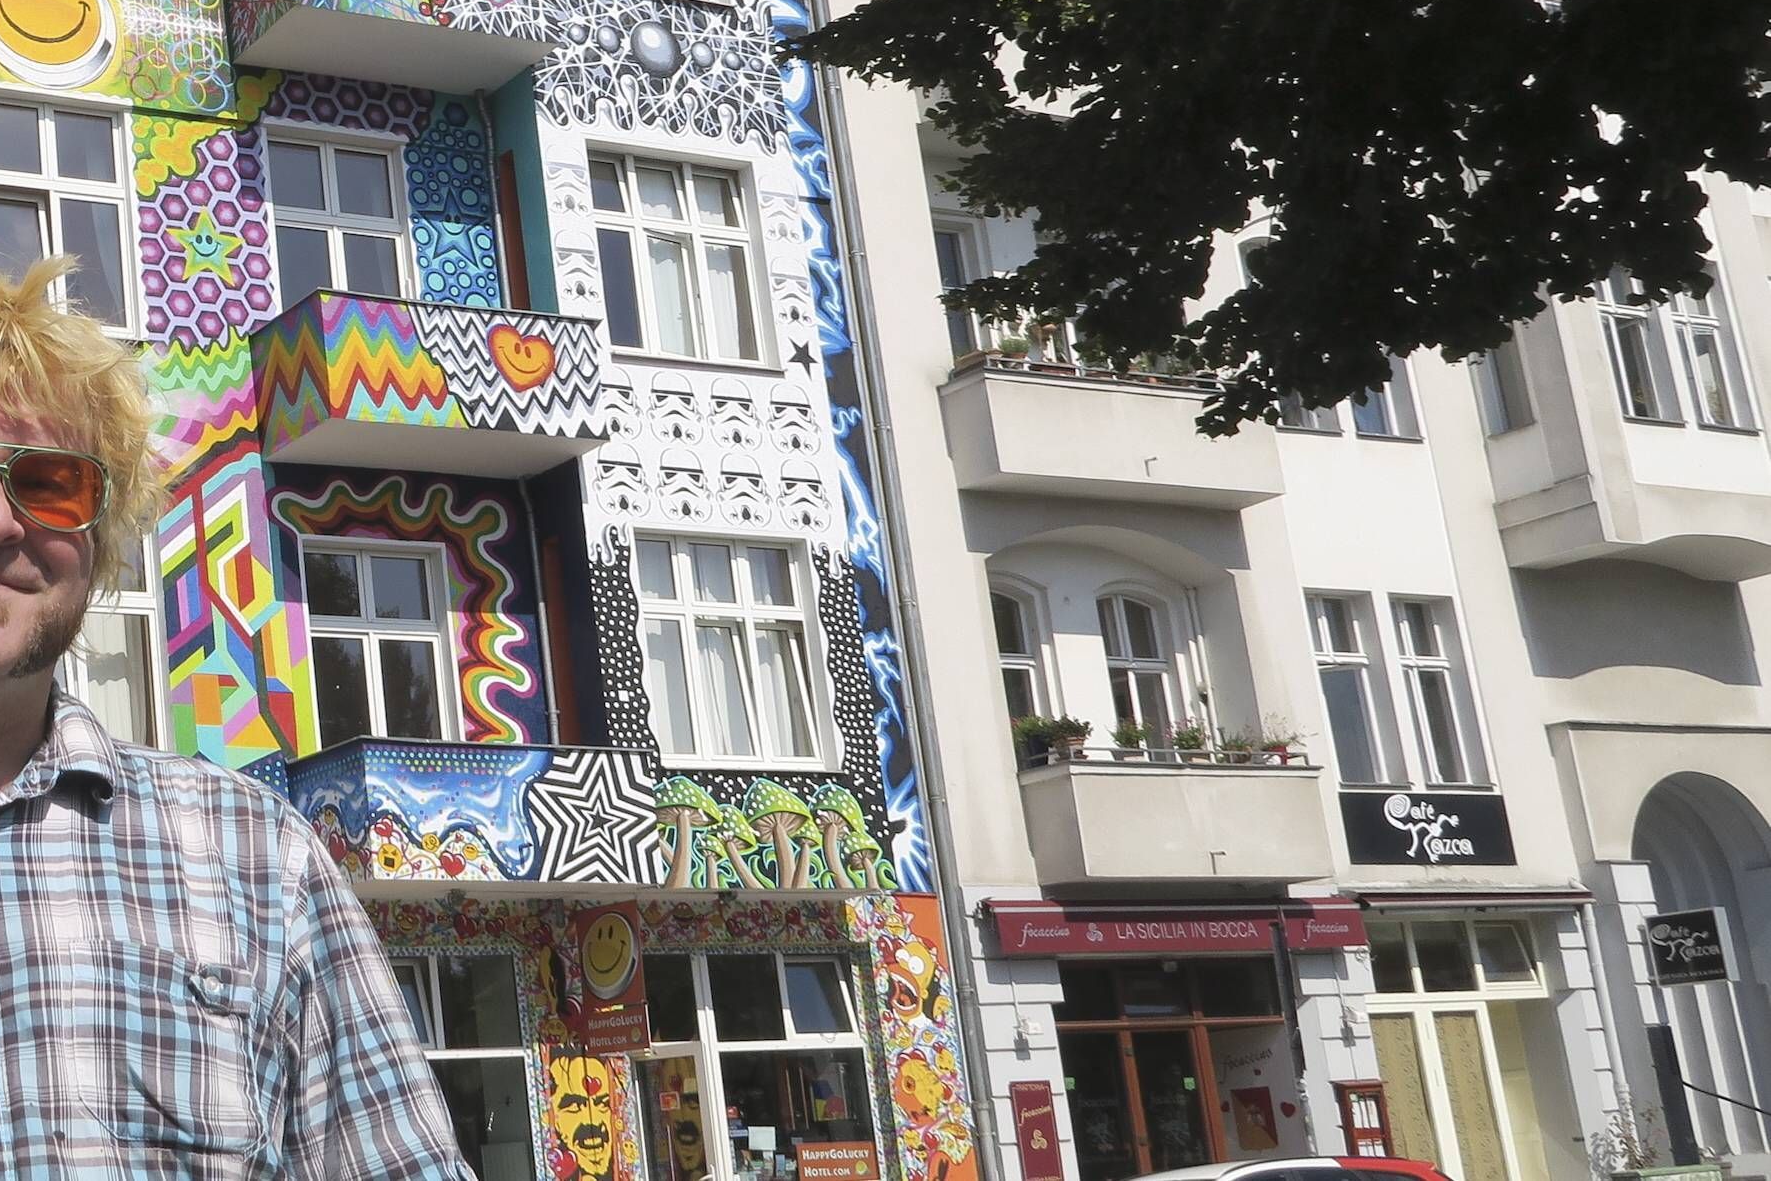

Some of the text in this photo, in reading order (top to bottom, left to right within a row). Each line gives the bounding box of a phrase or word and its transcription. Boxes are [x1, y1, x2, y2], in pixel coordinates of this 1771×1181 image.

[1017, 922, 1071, 947] focaccino
[1115, 920, 1259, 940] LA SICILIA IN BOCCA
[1302, 919, 1350, 942] focaccino
